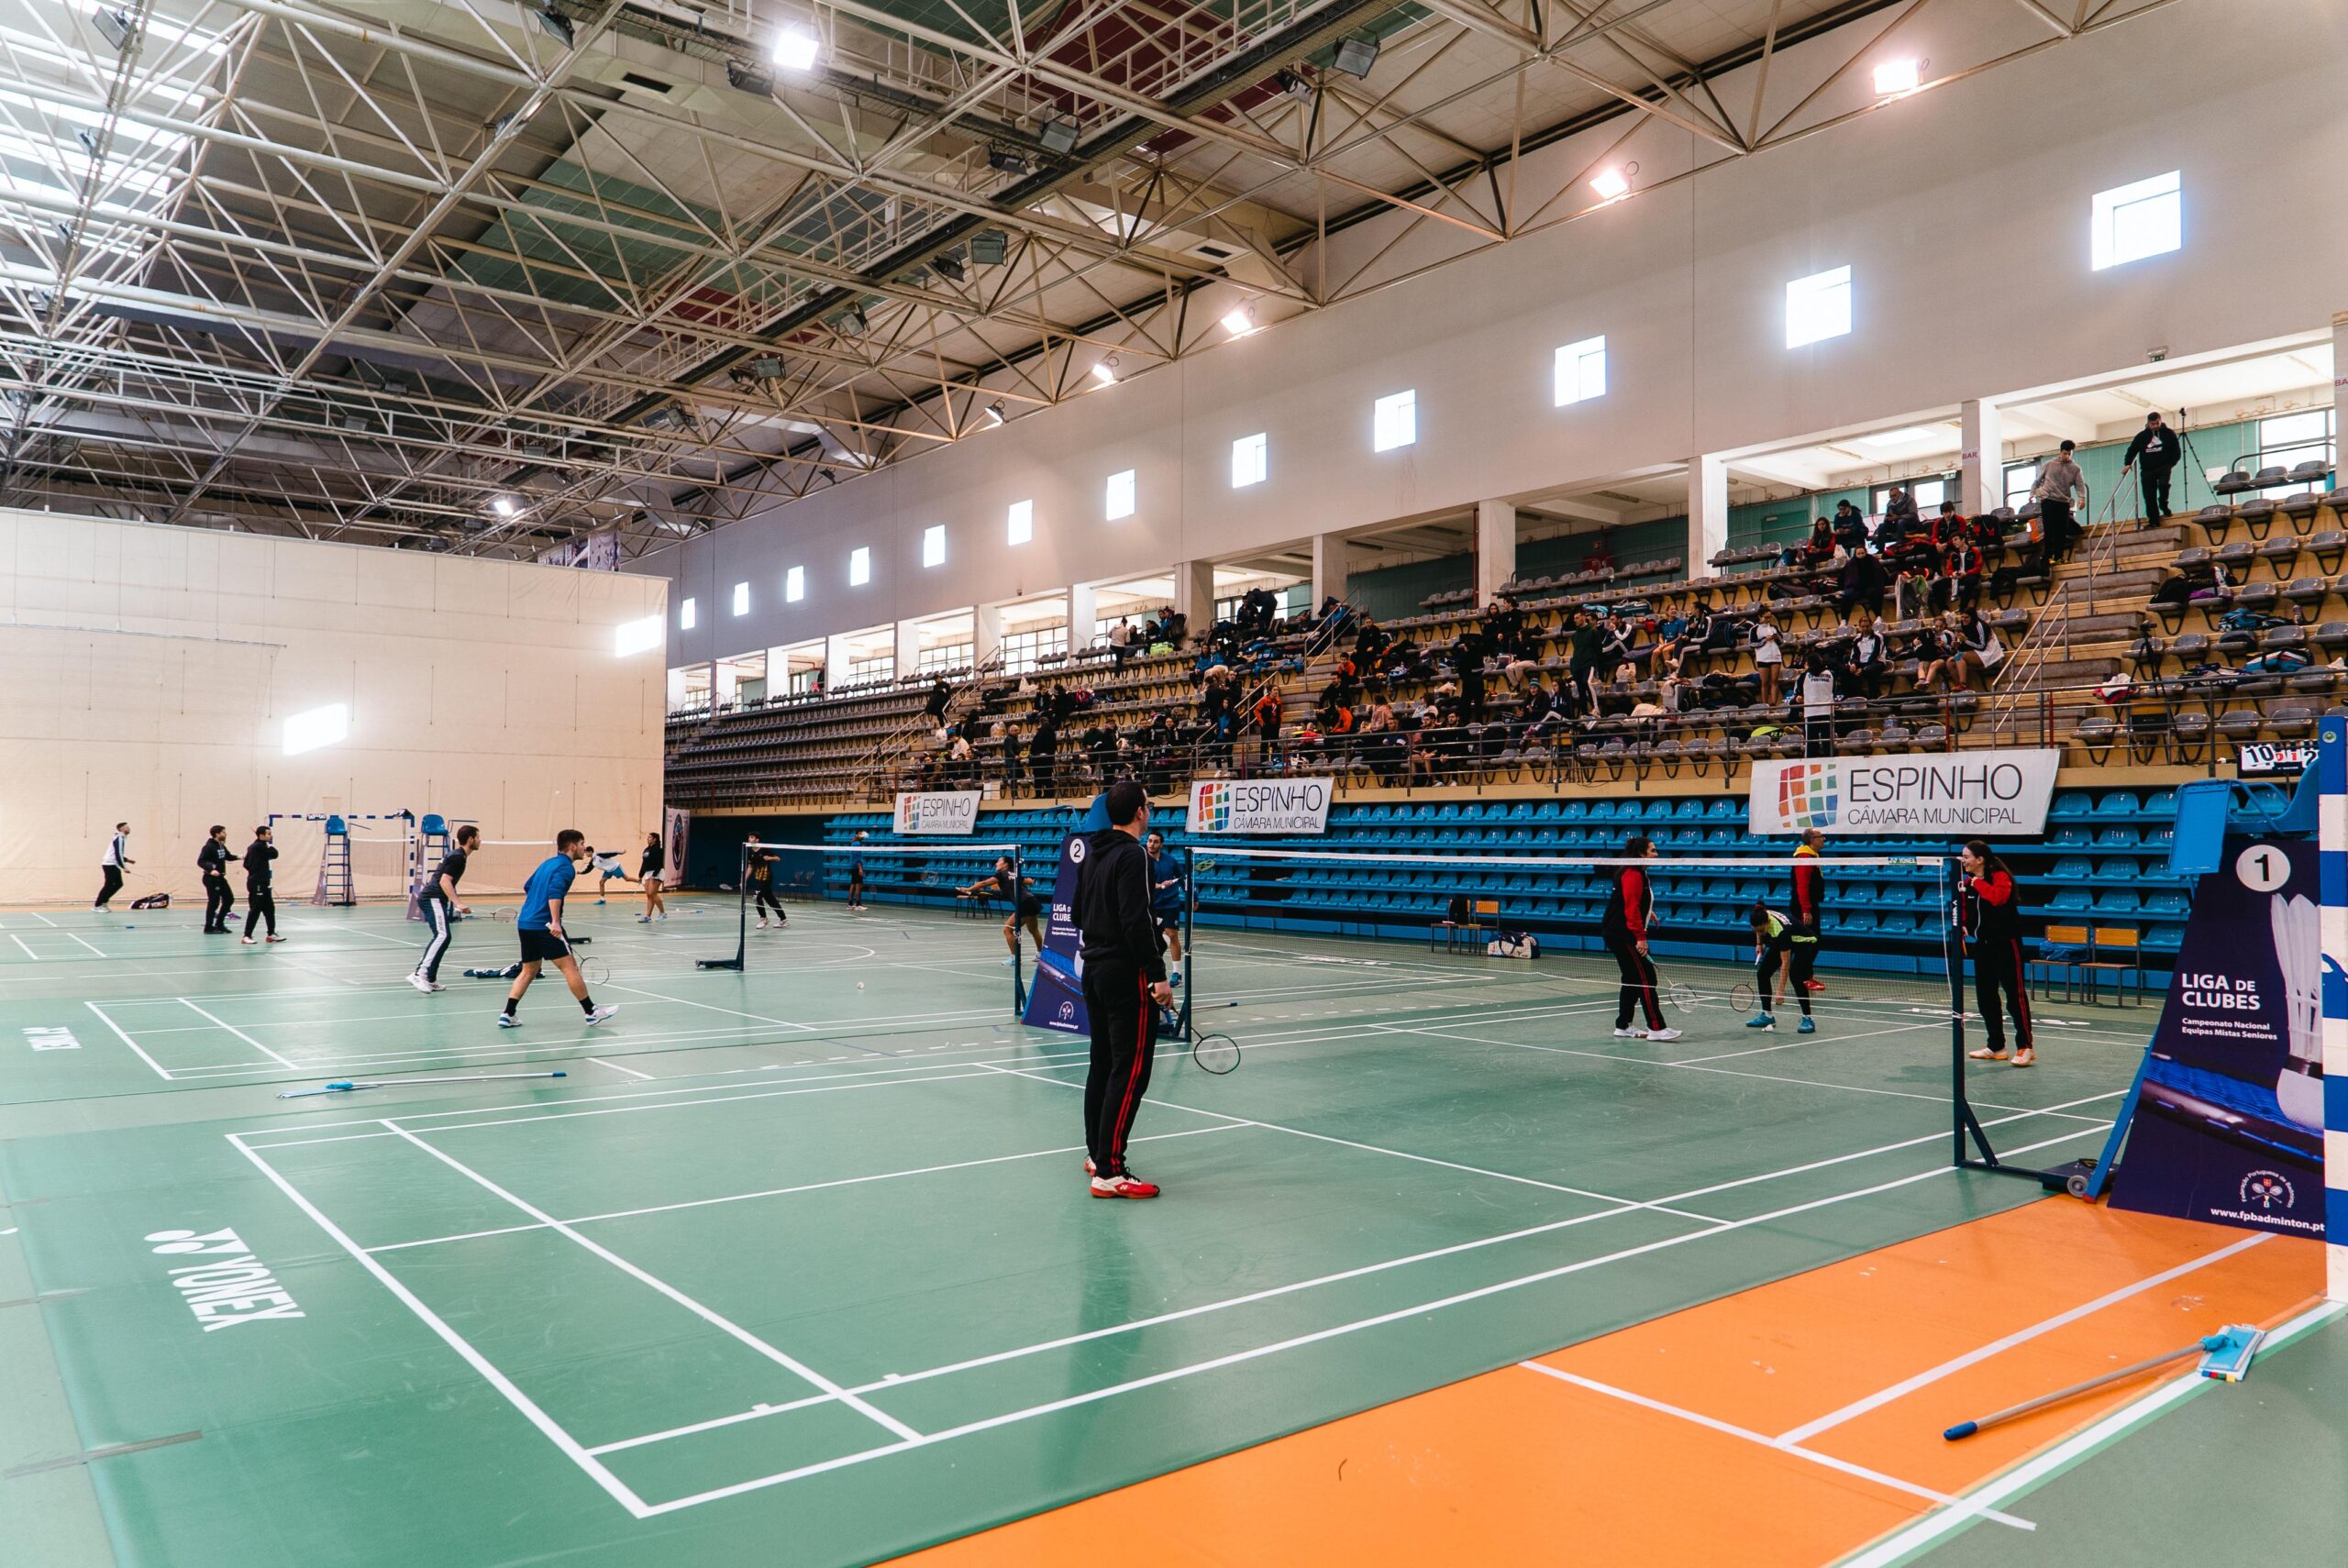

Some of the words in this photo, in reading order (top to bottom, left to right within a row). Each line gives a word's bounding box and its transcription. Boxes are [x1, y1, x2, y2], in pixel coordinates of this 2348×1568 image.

[2245, 746, 2275, 763] 10
[1849, 763, 2023, 802] ESPINHO
[922, 797, 971, 817] ESPINHO
[1235, 784, 1324, 812] ESPINHO
[1234, 814, 1272, 829] CÂMARA
[1272, 816, 1321, 829] MUNICIPAL
[1847, 804, 1920, 825] CÂMARA
[1923, 806, 2022, 825] MUNICIPAL
[1074, 844, 1081, 858] 2
[2254, 854, 2270, 882] 1
[1053, 903, 1067, 912] LIGA
[1052, 913, 1072, 922] CLUBE
[2181, 973, 2231, 990] LIGA
[2235, 979, 2256, 992] DE
[2182, 991, 2262, 1010] CLUBES
[2182, 1017, 2233, 1028] Campeonato
[2233, 1021, 2271, 1031] Nacional
[2182, 1027, 2213, 1036] Equipas
[2214, 1029, 2241, 1038] Mistas
[2242, 1031, 2278, 1041] Seniores
[2210, 1208, 2326, 1232] www.fpbadminton.pt
[168, 1254, 307, 1332] YONEX
